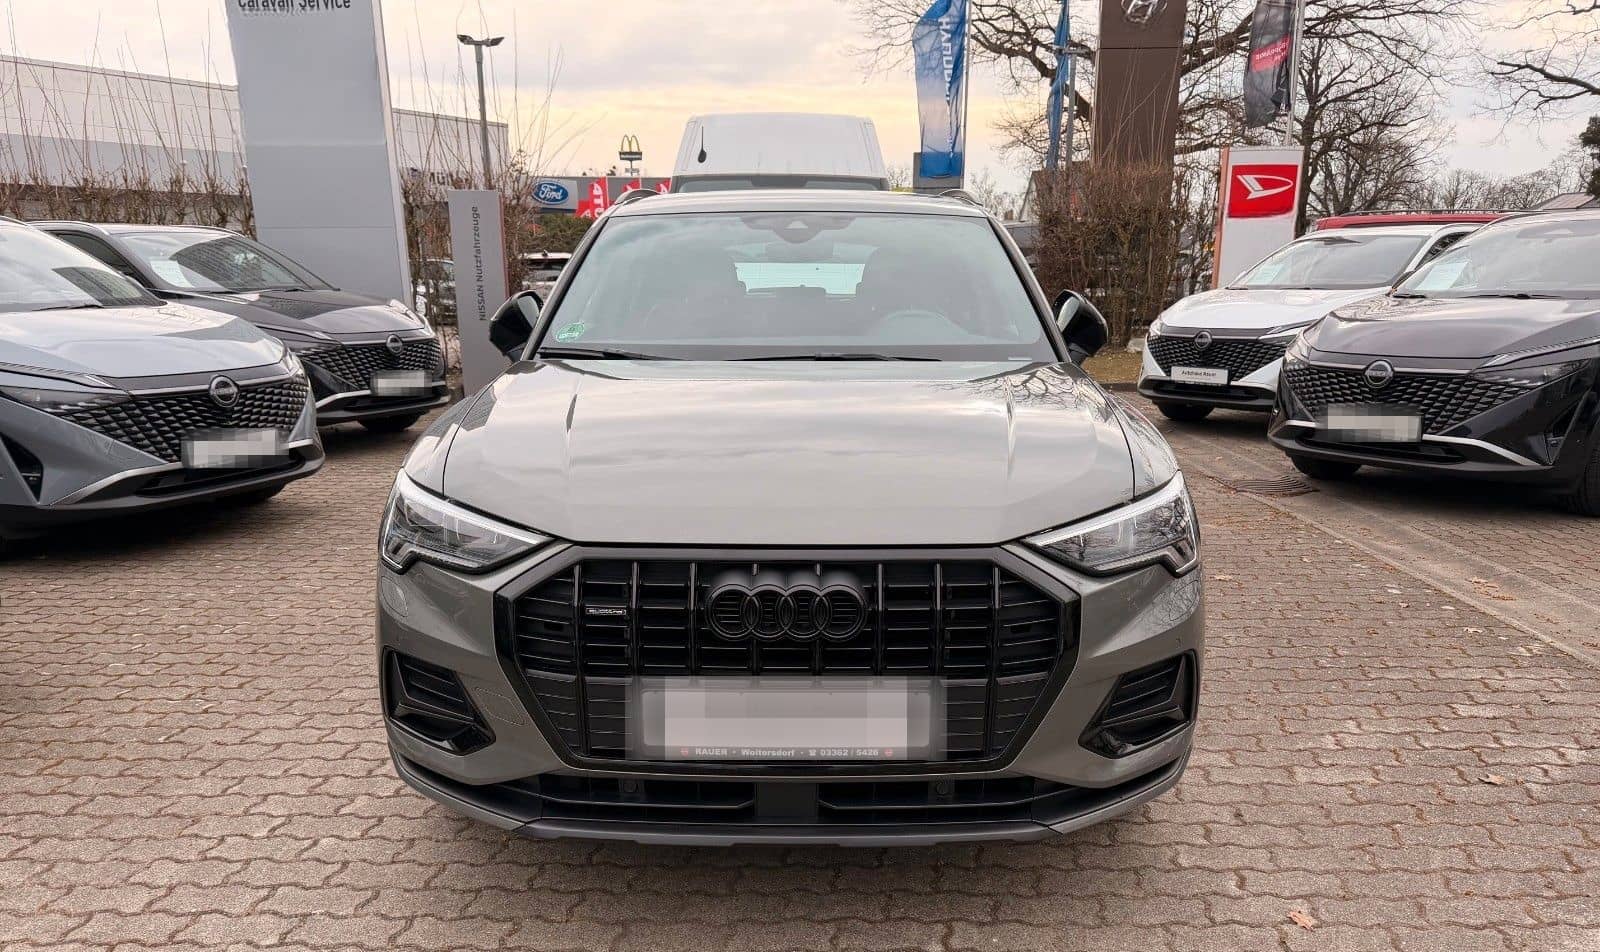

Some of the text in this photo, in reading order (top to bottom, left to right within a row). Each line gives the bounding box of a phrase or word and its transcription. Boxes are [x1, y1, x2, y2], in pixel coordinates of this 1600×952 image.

[538, 184, 563, 200] Ford
[471, 206, 486, 321] NISSAN Nutzfahrzeuge
